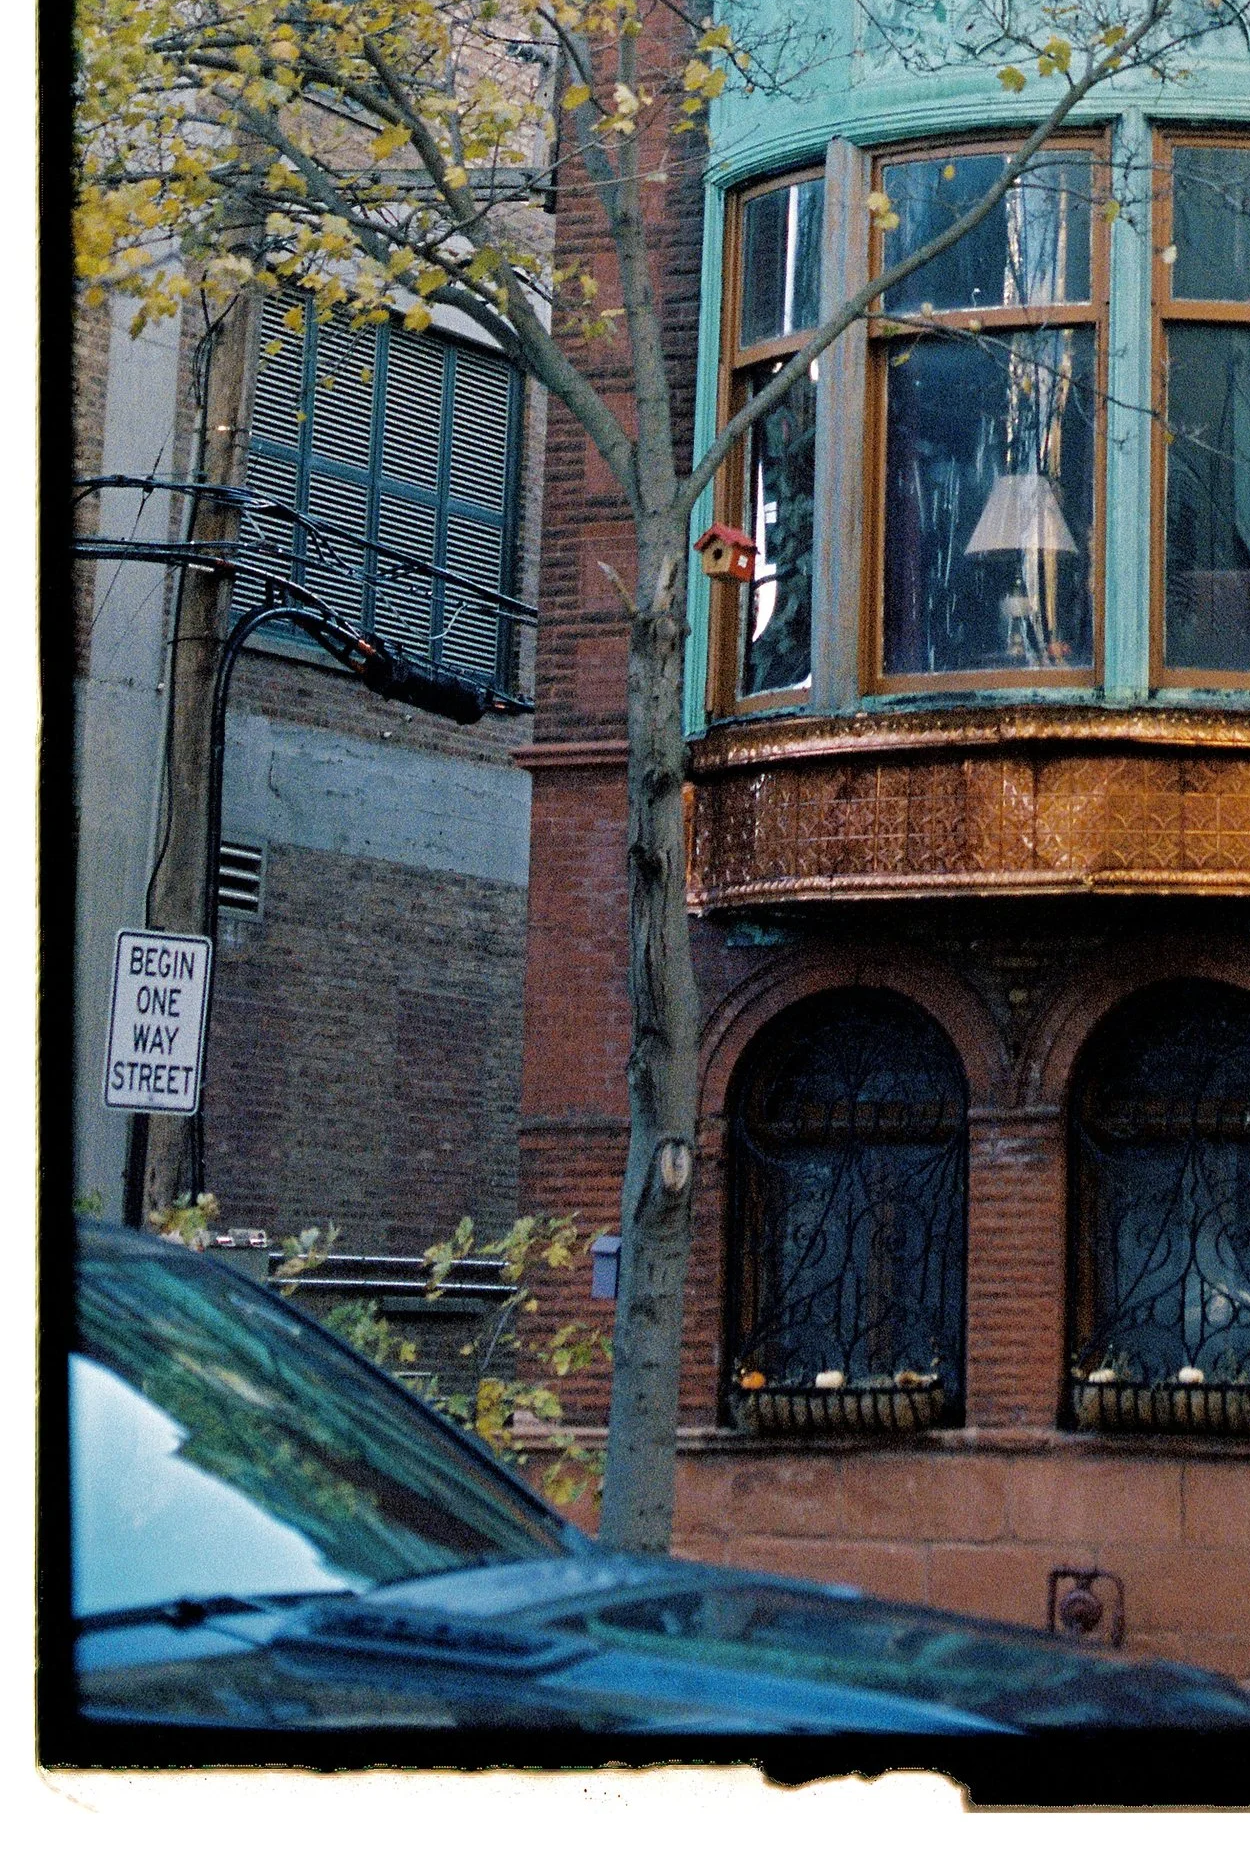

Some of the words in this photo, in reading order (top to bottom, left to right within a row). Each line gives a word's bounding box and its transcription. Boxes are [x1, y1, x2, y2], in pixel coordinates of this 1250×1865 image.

[130, 946, 195, 980] BEGIN
[137, 986, 181, 1018] ONE
[133, 1023, 179, 1056] WAY
[111, 1061, 193, 1095] STREET
